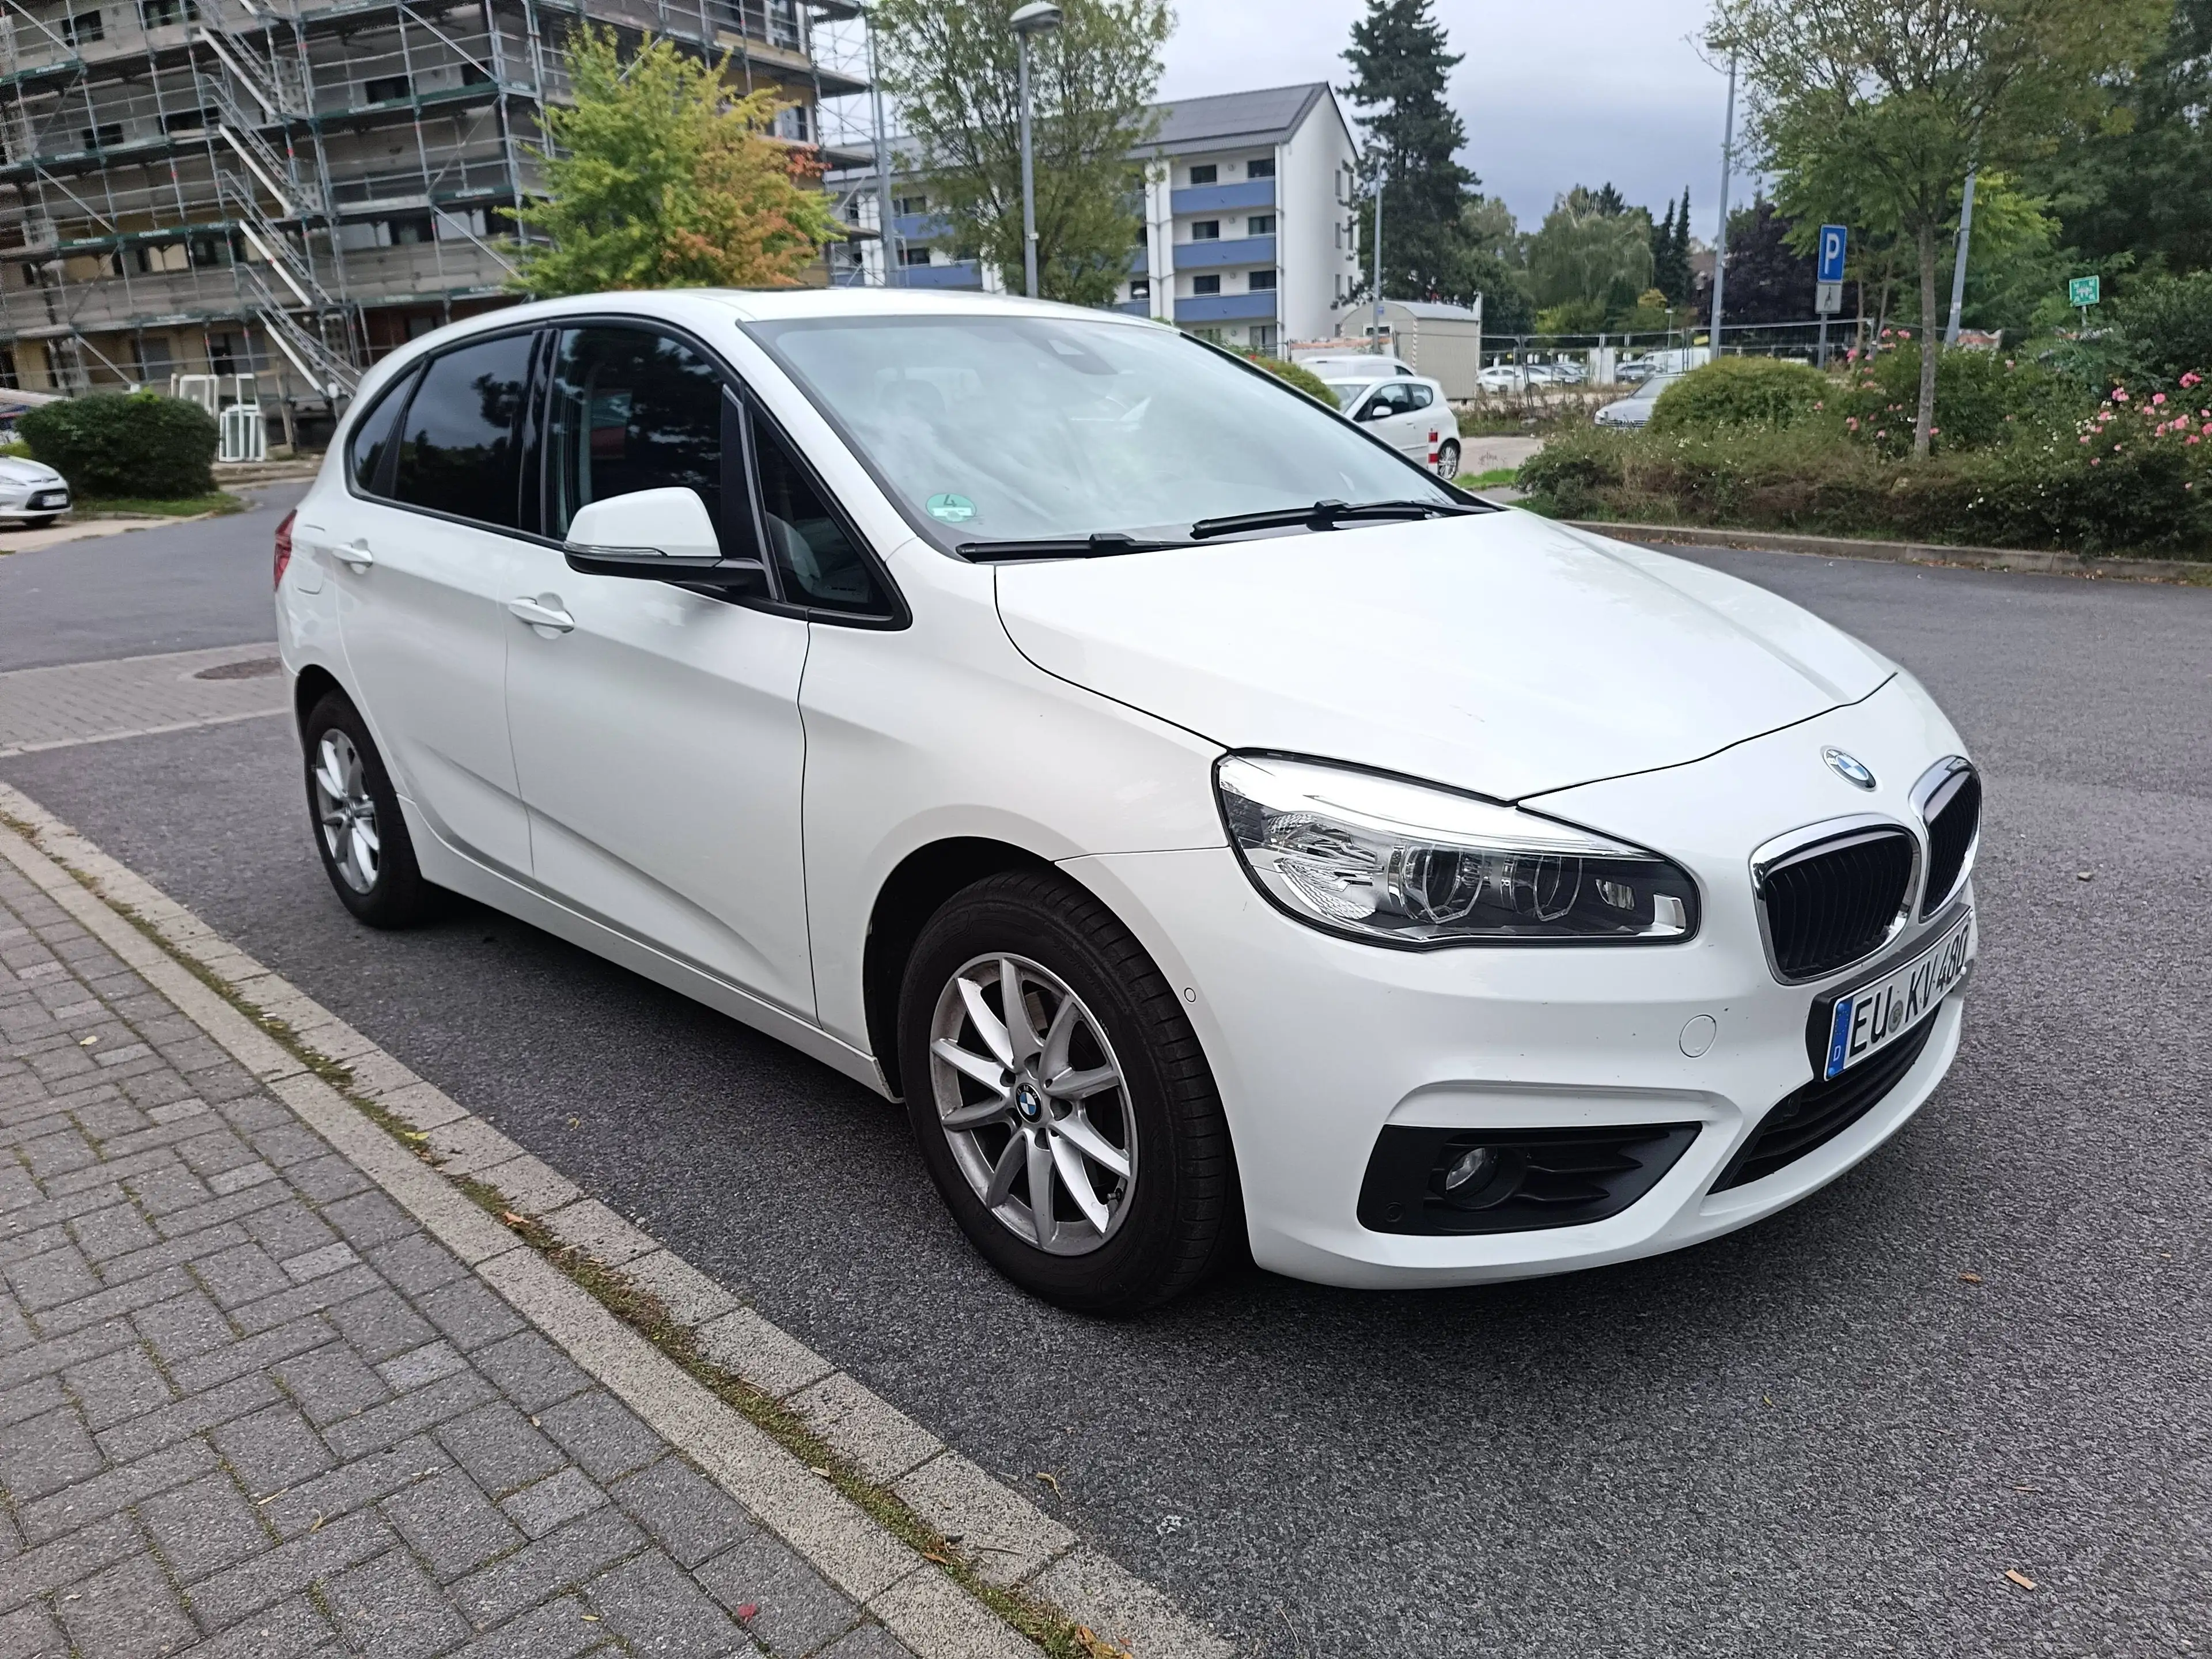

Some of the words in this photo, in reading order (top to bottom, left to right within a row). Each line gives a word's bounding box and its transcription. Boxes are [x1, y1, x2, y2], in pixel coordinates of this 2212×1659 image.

[1824, 233, 1840, 274] P
[943, 494, 957, 507] 4
[1849, 984, 1893, 1058] EU
[1833, 1046, 1840, 1062] D
[1016, 1085, 1038, 1099] BMW
